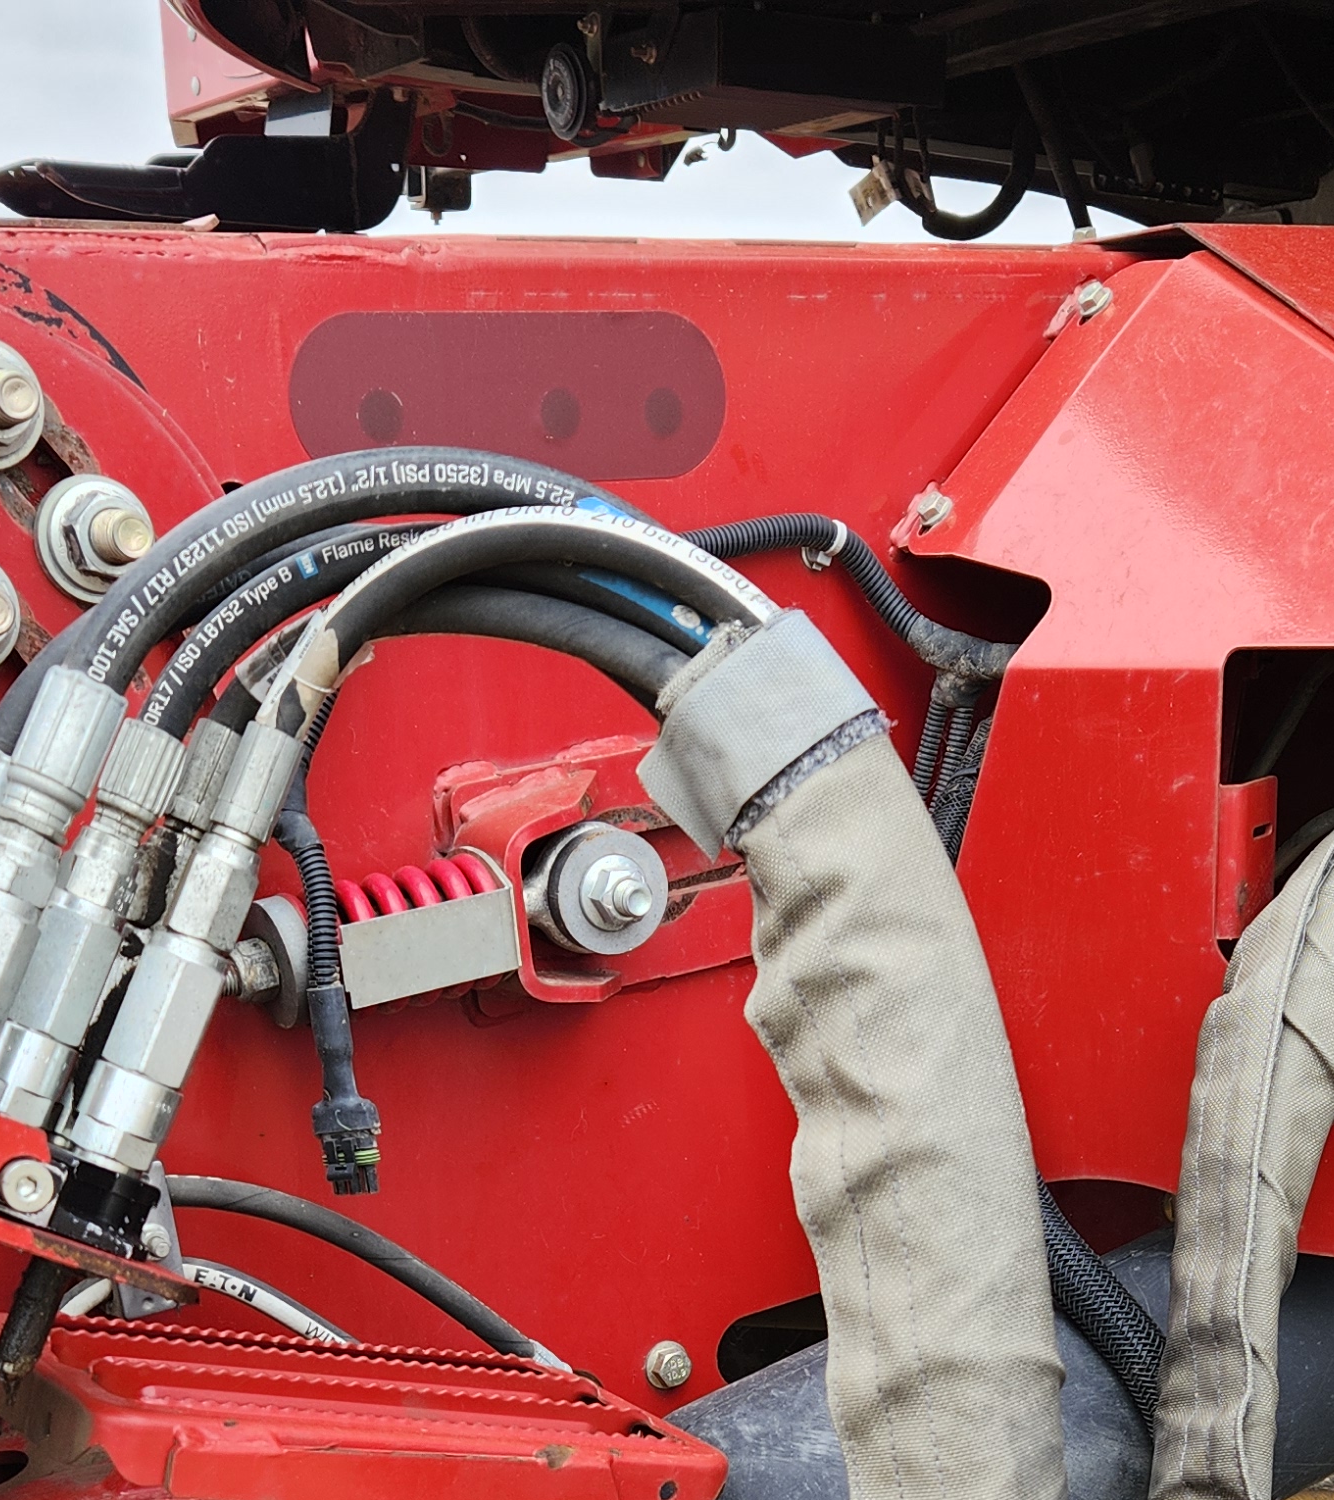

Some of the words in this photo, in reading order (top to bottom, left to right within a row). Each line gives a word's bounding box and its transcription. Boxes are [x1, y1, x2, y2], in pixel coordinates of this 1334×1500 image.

[392, 460, 429, 484] PSI)
[435, 463, 488, 487] (3250
[494, 468, 532, 494] MPa
[252, 490, 296, 522] mm)
[223, 510, 254, 539] ISO
[642, 524, 682, 547] bar
[172, 527, 225, 578] 11237
[142, 564, 175, 607] R17
[174, 643, 201, 673] ISO
[196, 600, 245, 648] 18752
[240, 574, 279, 607] Type
[277, 566, 293, 585] B
[322, 537, 374, 564] Flame
[106, 608, 139, 648] SAE
